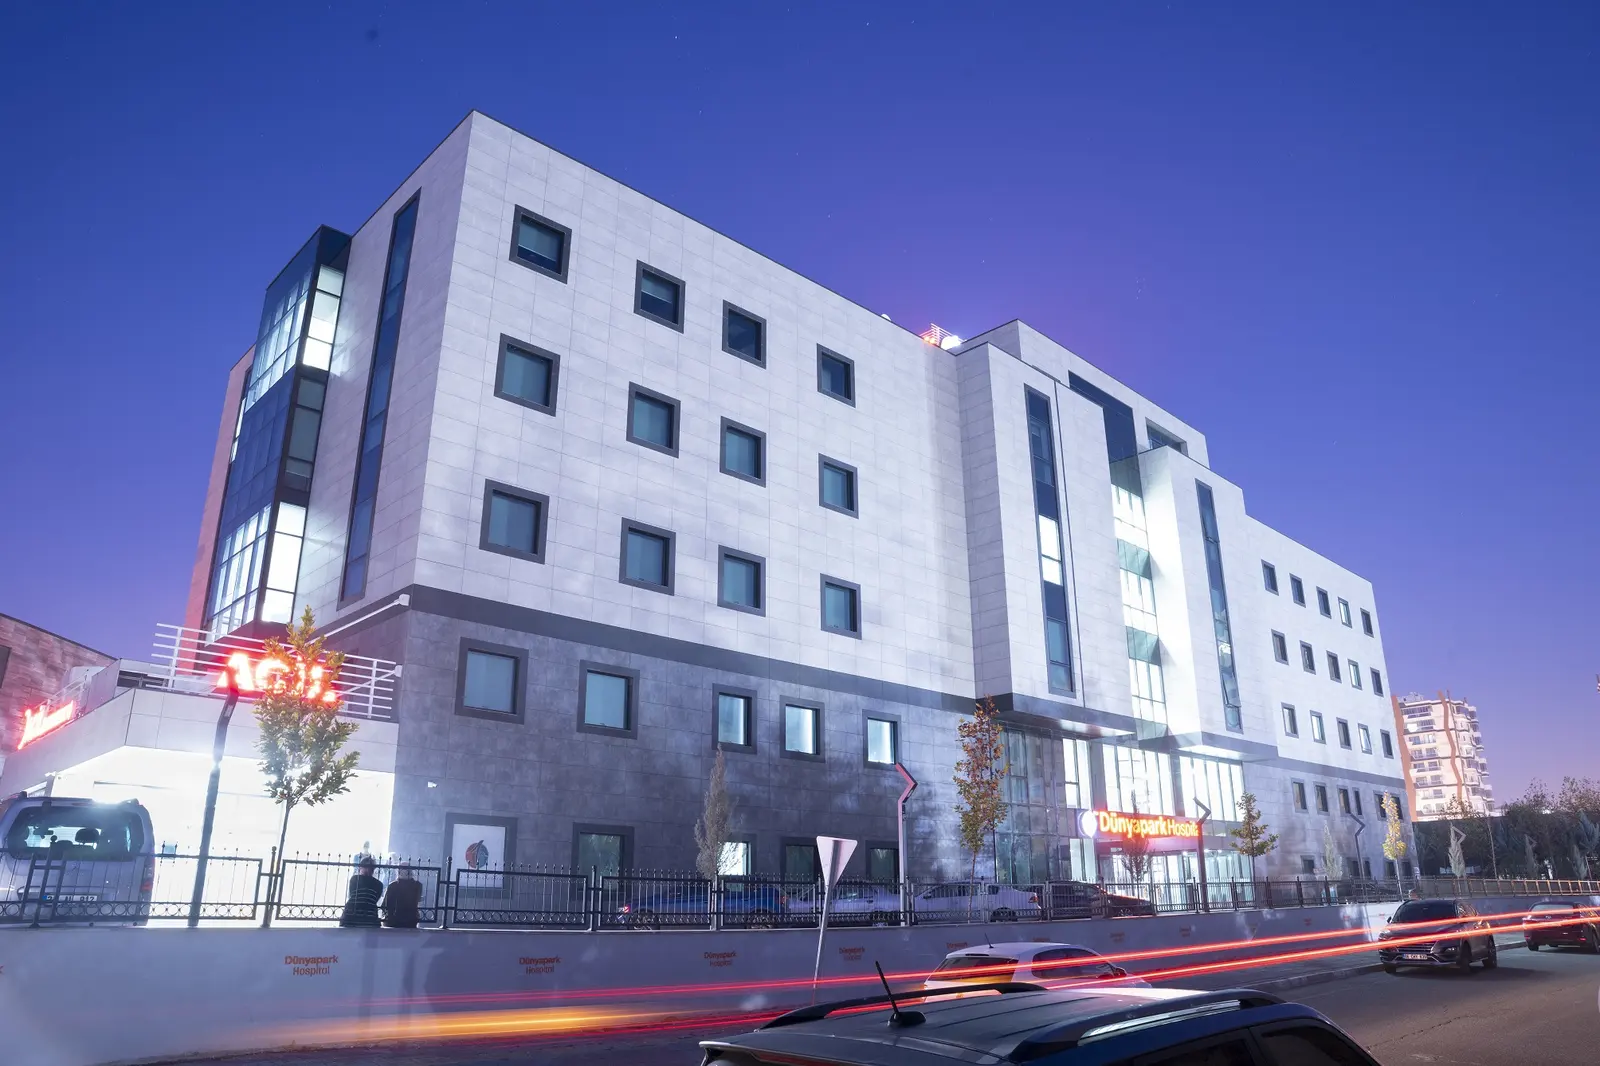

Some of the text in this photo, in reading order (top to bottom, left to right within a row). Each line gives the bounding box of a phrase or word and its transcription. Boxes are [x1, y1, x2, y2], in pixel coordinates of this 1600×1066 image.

[1100, 811, 1167, 838] Dünyapark
[284, 954, 338, 966] Dünyapark
[292, 965, 330, 977] Hospital
